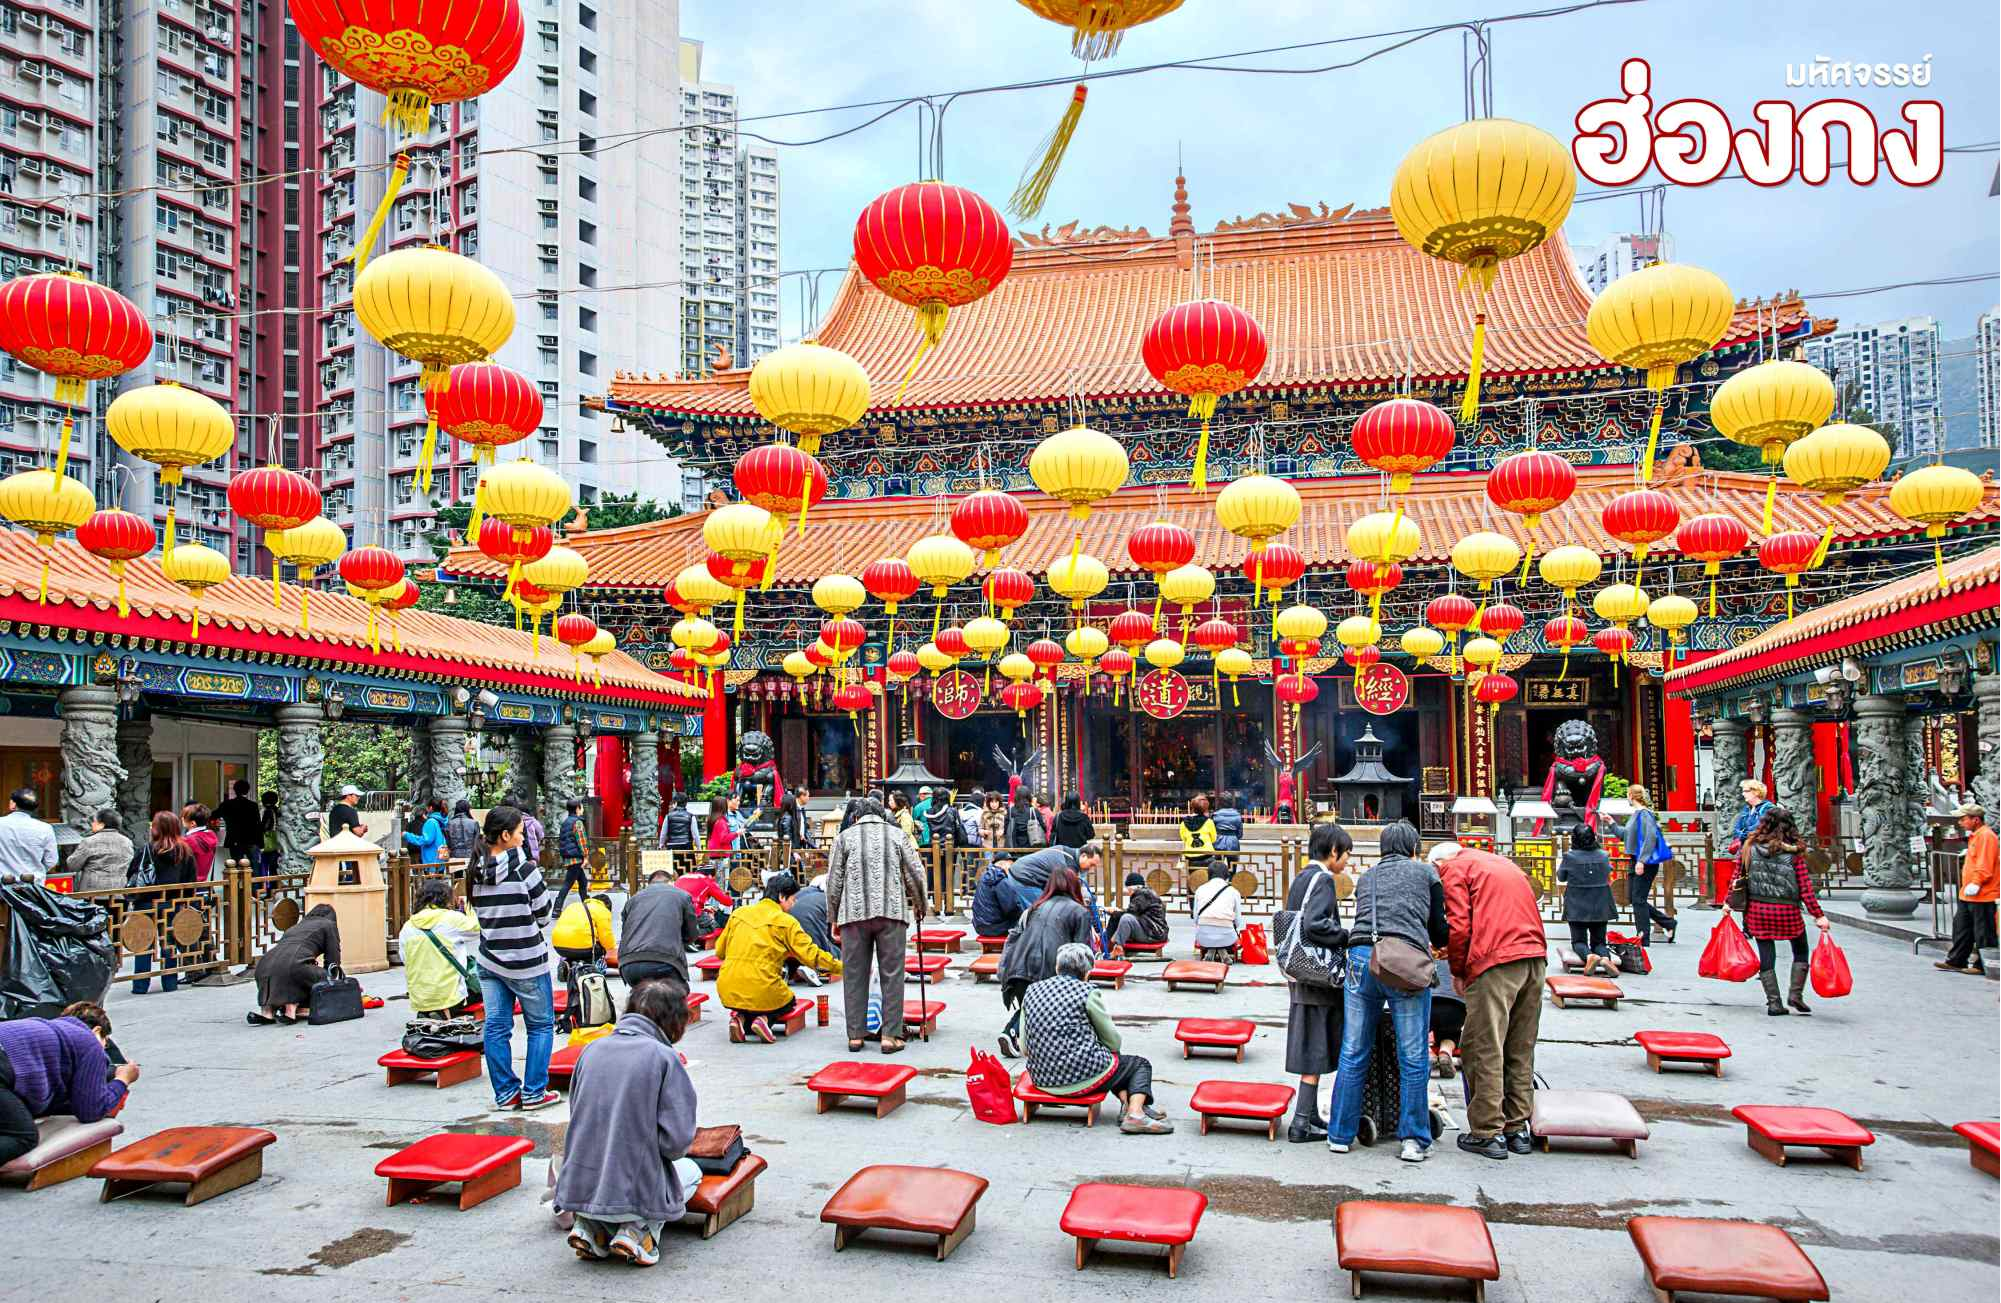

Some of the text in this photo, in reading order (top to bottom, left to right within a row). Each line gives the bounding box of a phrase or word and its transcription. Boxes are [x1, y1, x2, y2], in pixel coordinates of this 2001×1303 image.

[945, 682, 969, 708] 師
[1149, 678, 1178, 709] 道
[1365, 676, 1394, 702] 經
